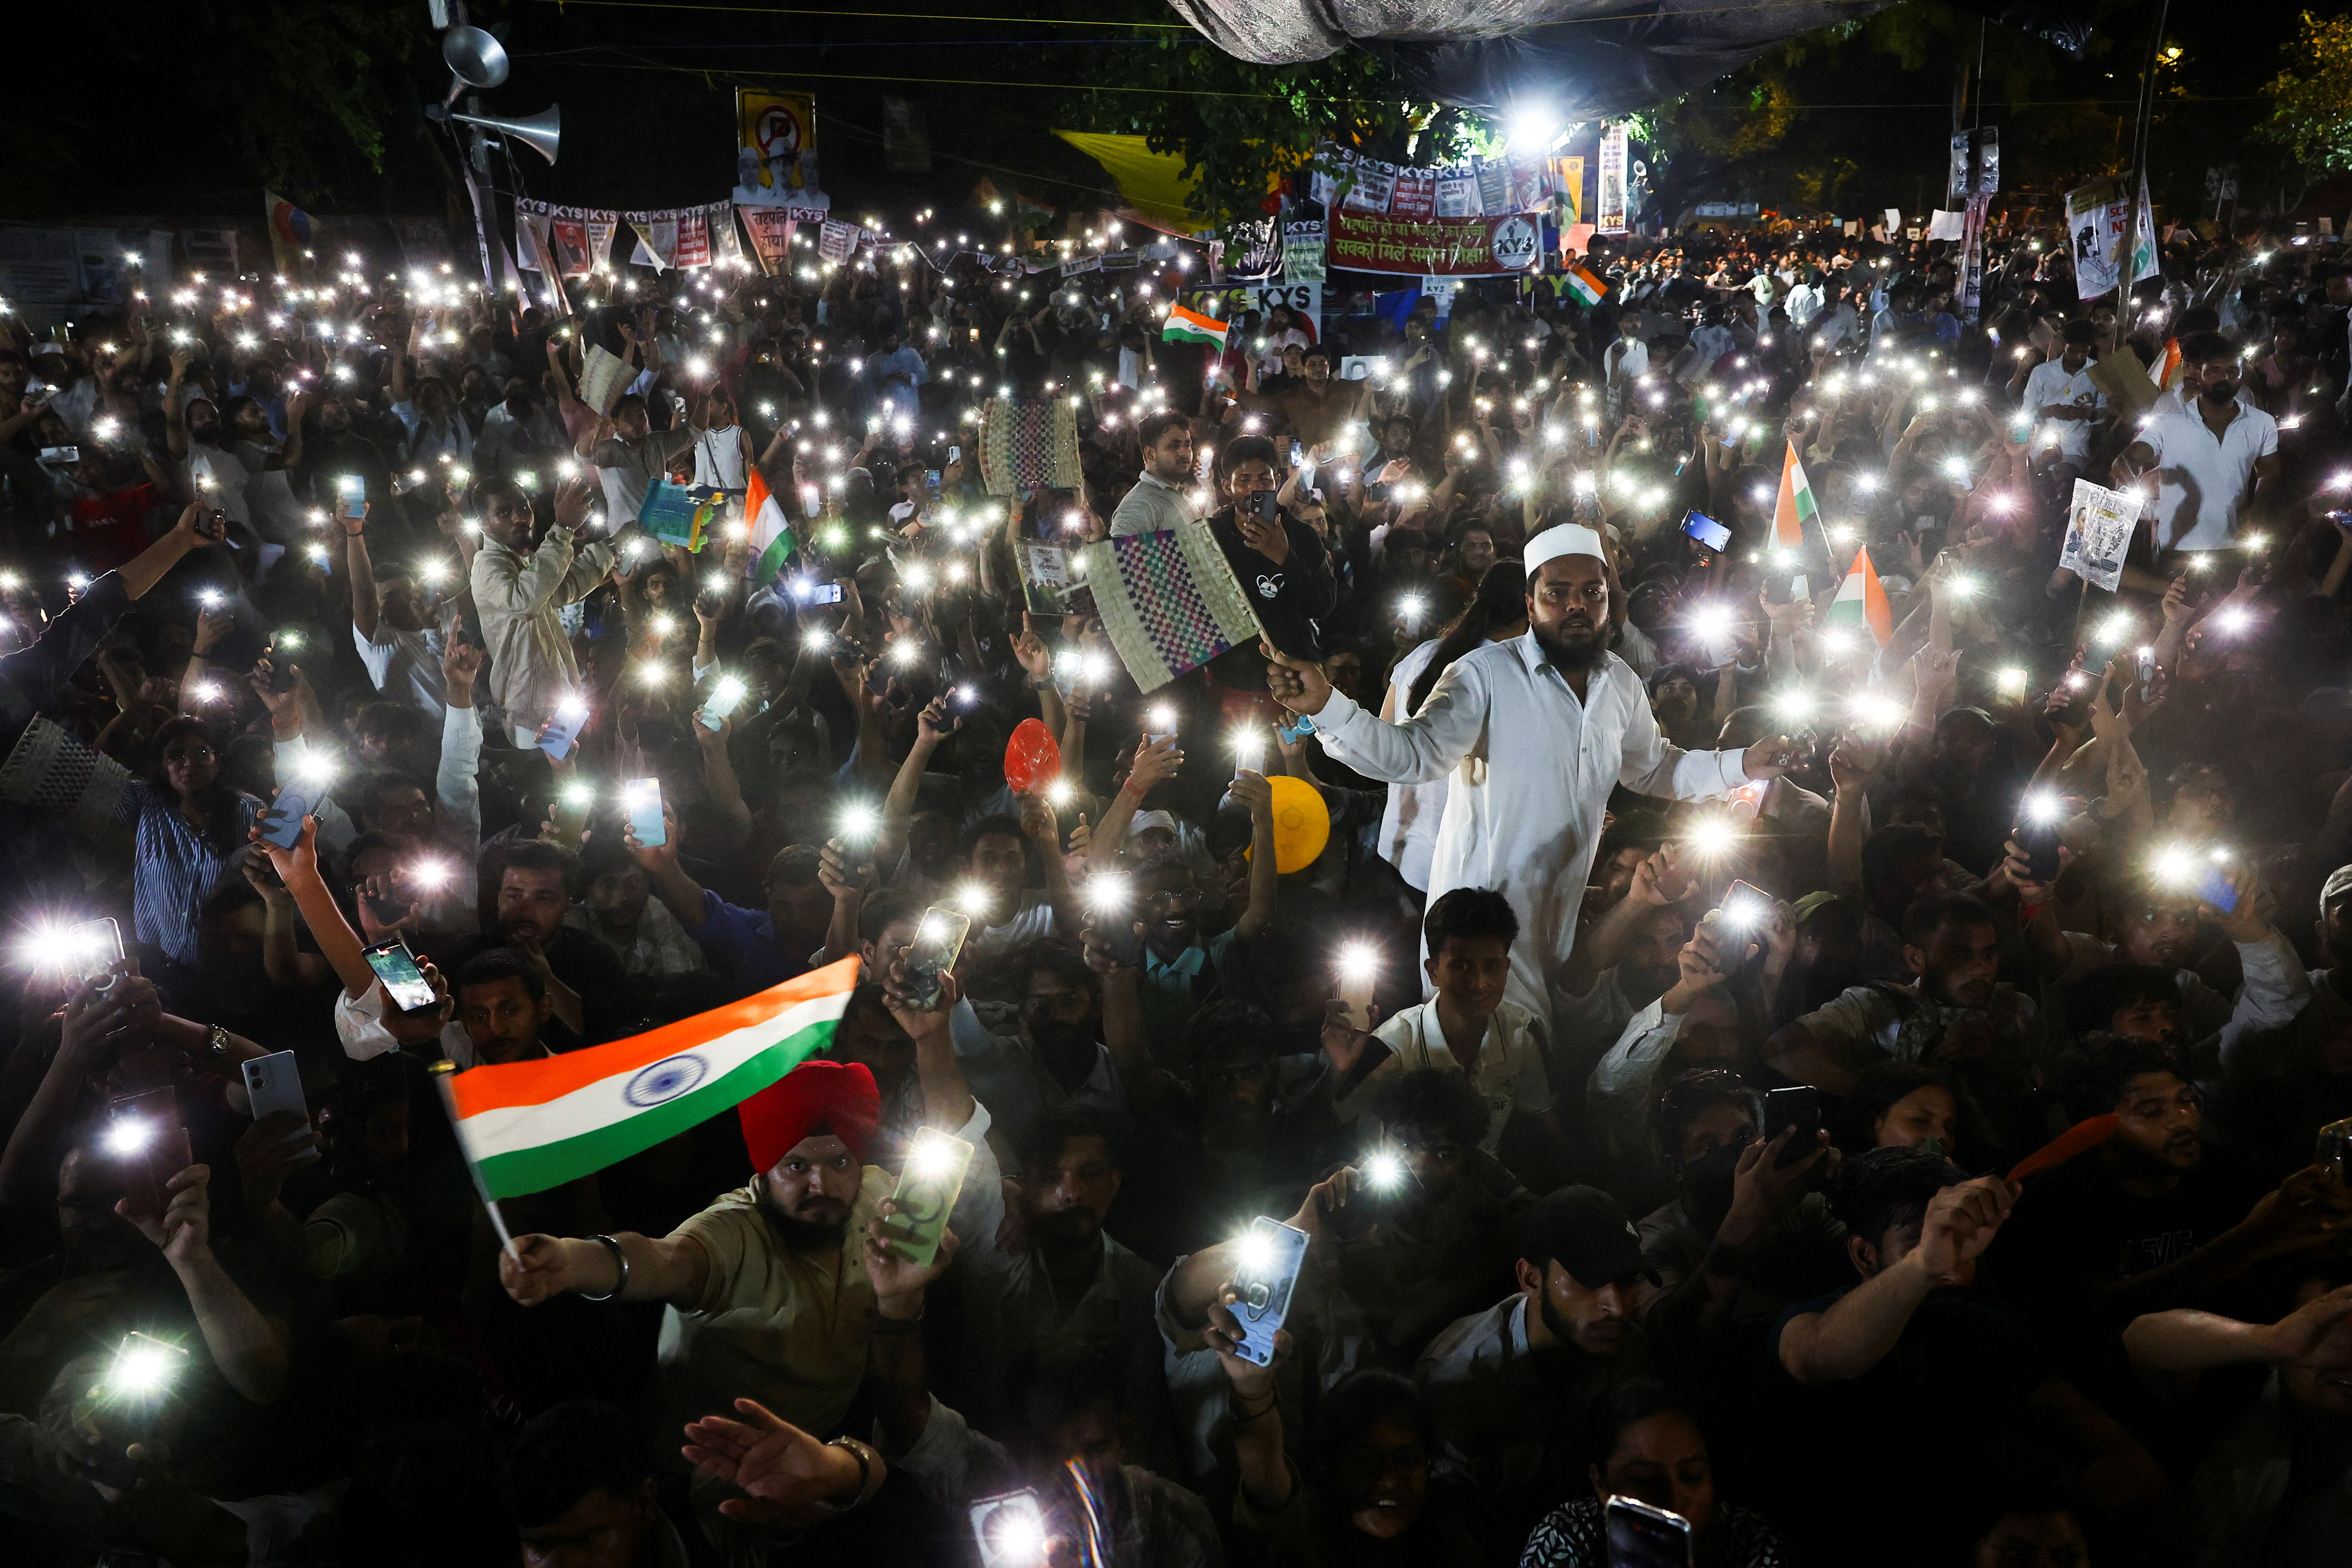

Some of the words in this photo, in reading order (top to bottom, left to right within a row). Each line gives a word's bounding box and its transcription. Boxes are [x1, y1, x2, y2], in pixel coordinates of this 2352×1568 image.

[1359, 155, 1395, 173] KYS
[1399, 166, 1434, 179] KYS
[1437, 166, 1474, 179] KYS
[516, 197, 547, 213] KYS
[553, 205, 583, 219] KYS
[590, 210, 617, 221] KYS
[651, 209, 676, 220] KYS
[792, 209, 824, 220] KYS
[1286, 220, 1321, 232] KYS
[1601, 216, 1623, 227] KYS
[1335, 236, 1376, 259] सबको
[1498, 236, 1533, 255] KYS
[1258, 286, 1310, 312] KYS
